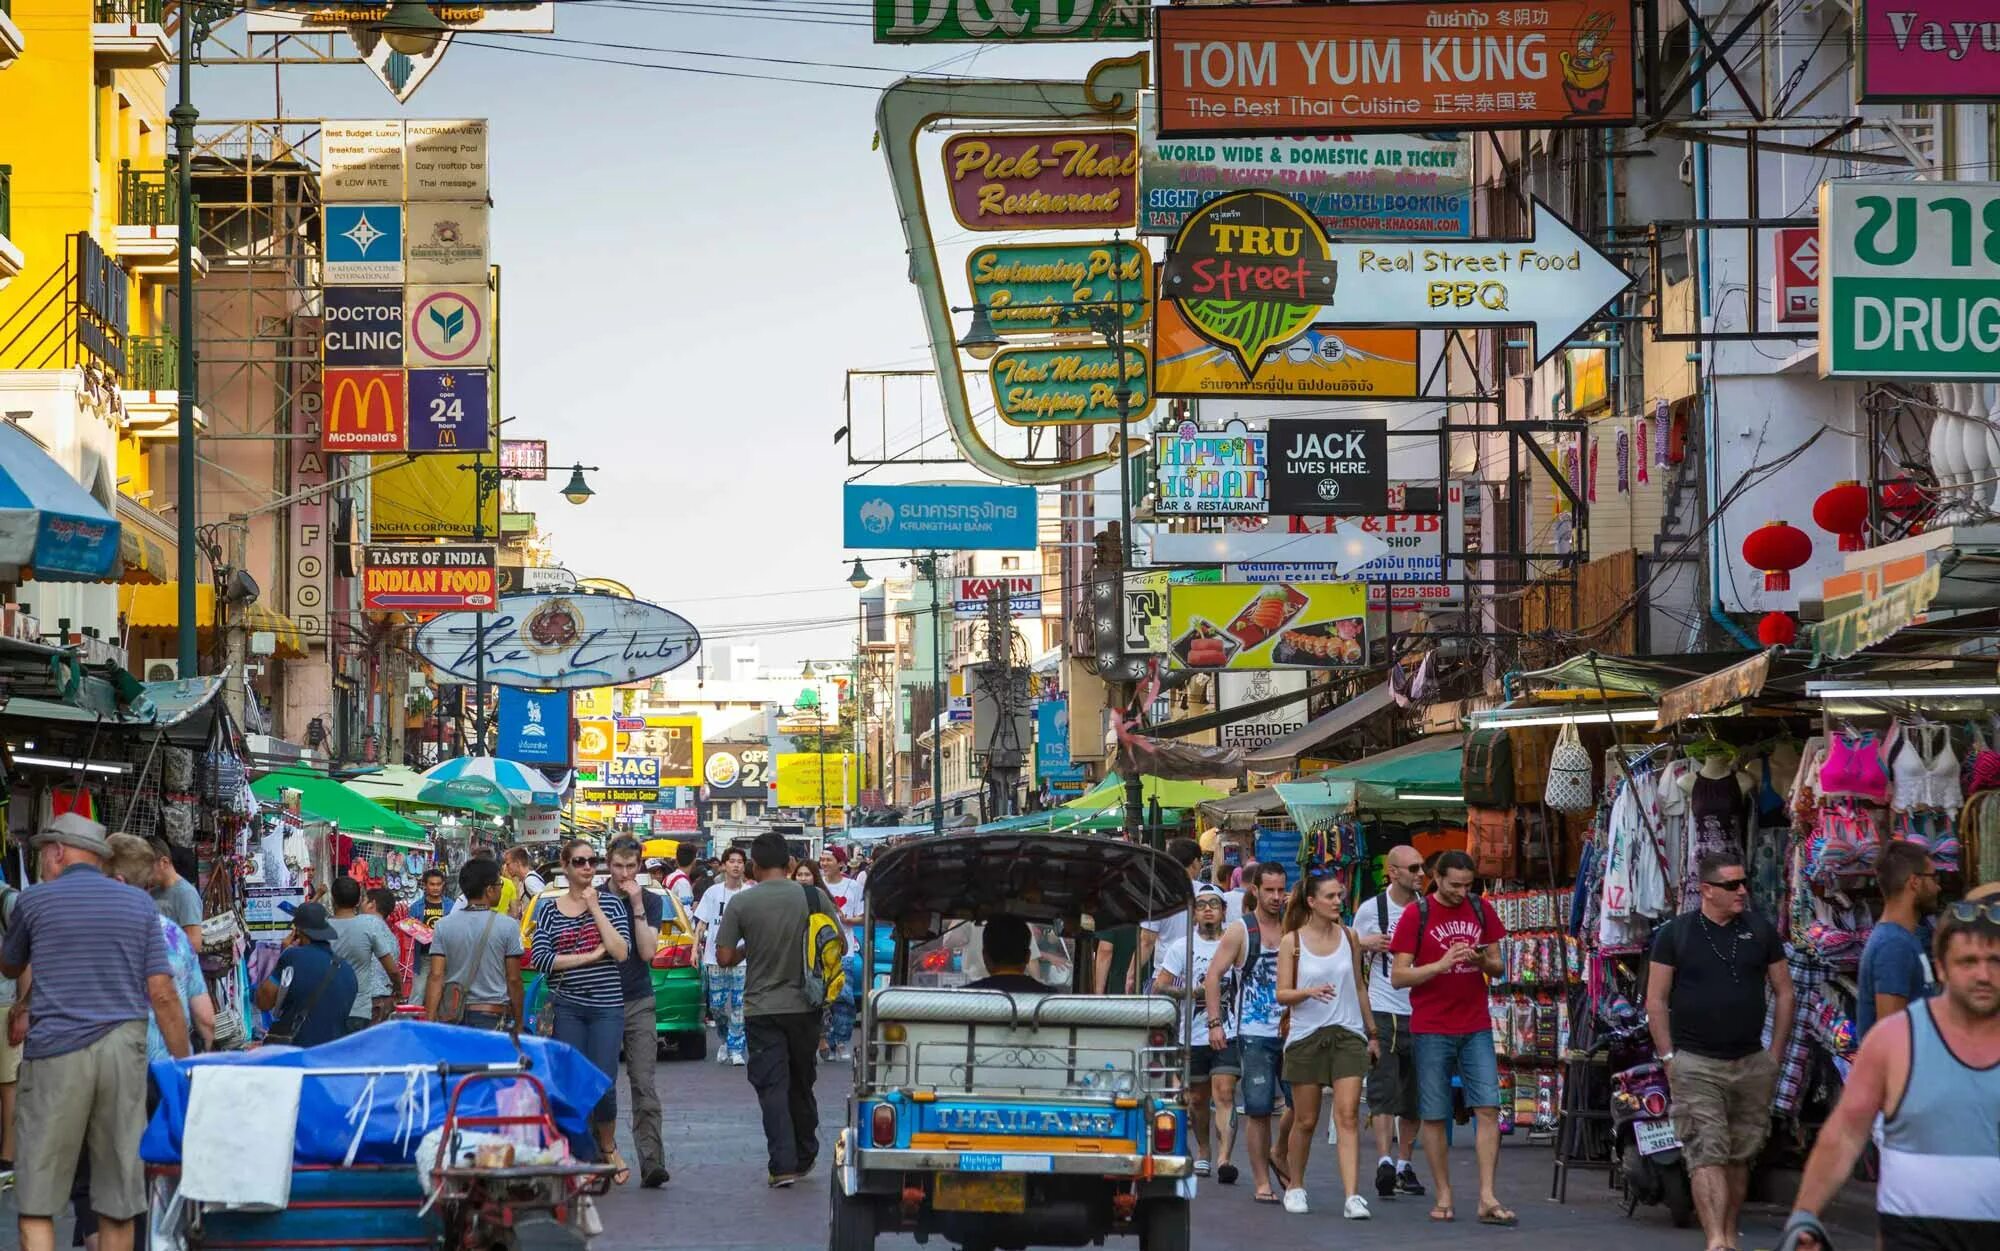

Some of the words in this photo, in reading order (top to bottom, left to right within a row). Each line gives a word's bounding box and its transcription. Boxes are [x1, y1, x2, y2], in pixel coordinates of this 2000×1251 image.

[441, 6, 486, 21] Hotel
[1495, 9, 1549, 26] 冬阴功
[1174, 41, 1277, 88] TOM
[1296, 38, 1400, 85] YUM
[1423, 34, 1548, 82] KUNG
[1187, 97, 1227, 118] The
[1234, 97, 1282, 117] Best
[1291, 95, 1334, 115] Thai
[1340, 94, 1422, 115] Cuisine
[1432, 91, 1538, 114] 正宗泰国菜
[325, 130, 343, 138] Best
[345, 130, 373, 139] Budget
[328, 146, 364, 154] Breakfast
[368, 146, 401, 154] included
[415, 145, 458, 155] Swimming
[460, 145, 478, 153] Pool
[1158, 144, 1216, 162] WORLD
[1223, 146, 1263, 163] WIDE
[1270, 147, 1282, 163] &
[1290, 146, 1368, 166] DOMESTIC
[1374, 149, 1401, 166] AIR
[1406, 149, 1458, 168] TICKET
[369, 163, 401, 171] internet
[415, 163, 434, 171] Cozy
[437, 162, 467, 171] rooftop
[419, 179, 437, 187] Thai
[439, 180, 477, 189] message
[977, 183, 1121, 217] Restaurant
[1149, 188, 1199, 208] SIGHT
[1329, 193, 1379, 211] HOTEL
[1383, 194, 1460, 213] BOOKING
[1210, 224, 1303, 257] TRU
[1358, 249, 1414, 273] Real
[1422, 249, 1512, 273] Street
[1518, 249, 1581, 272] Food
[975, 254, 1087, 290] Swimming
[1192, 257, 1311, 300] Street
[1427, 280, 1509, 311] BBQ
[325, 306, 402, 321] DOCTOR
[1854, 296, 2000, 352] DRUG
[324, 331, 402, 350] CLINIC
[997, 357, 1049, 386] Thai
[430, 398, 464, 422] 24
[438, 422, 457, 430] hours
[328, 432, 398, 443] McDonald's
[1286, 433, 1366, 459] JACK
[1287, 461, 1326, 474] LIVES
[900, 501, 1017, 524] ธนาคารกรุงไทย
[1157, 500, 1178, 511] BAR
[1183, 501, 1192, 511] &
[1197, 500, 1265, 512] RESTAURANT
[370, 523, 410, 531] SINGHA
[900, 523, 963, 532] KRUNGTHAI
[963, 523, 992, 532] BANK
[1387, 537, 1422, 548] SHOP
[372, 551, 418, 565] TASTE
[422, 552, 440, 565] OF
[445, 552, 487, 565] INDIA
[298, 525, 321, 636] FOOD
[367, 570, 436, 592] INDIAN
[441, 570, 491, 593] FOOD
[1373, 586, 1450, 598] 02629-3688
[449, 616, 531, 671] The
[570, 628, 683, 668] Club
[1225, 737, 1273, 748] TATTOO
[608, 758, 657, 776] BAG
[1430, 920, 1482, 943] CALIFORNIA
[935, 1108, 1116, 1133] THAILAND
